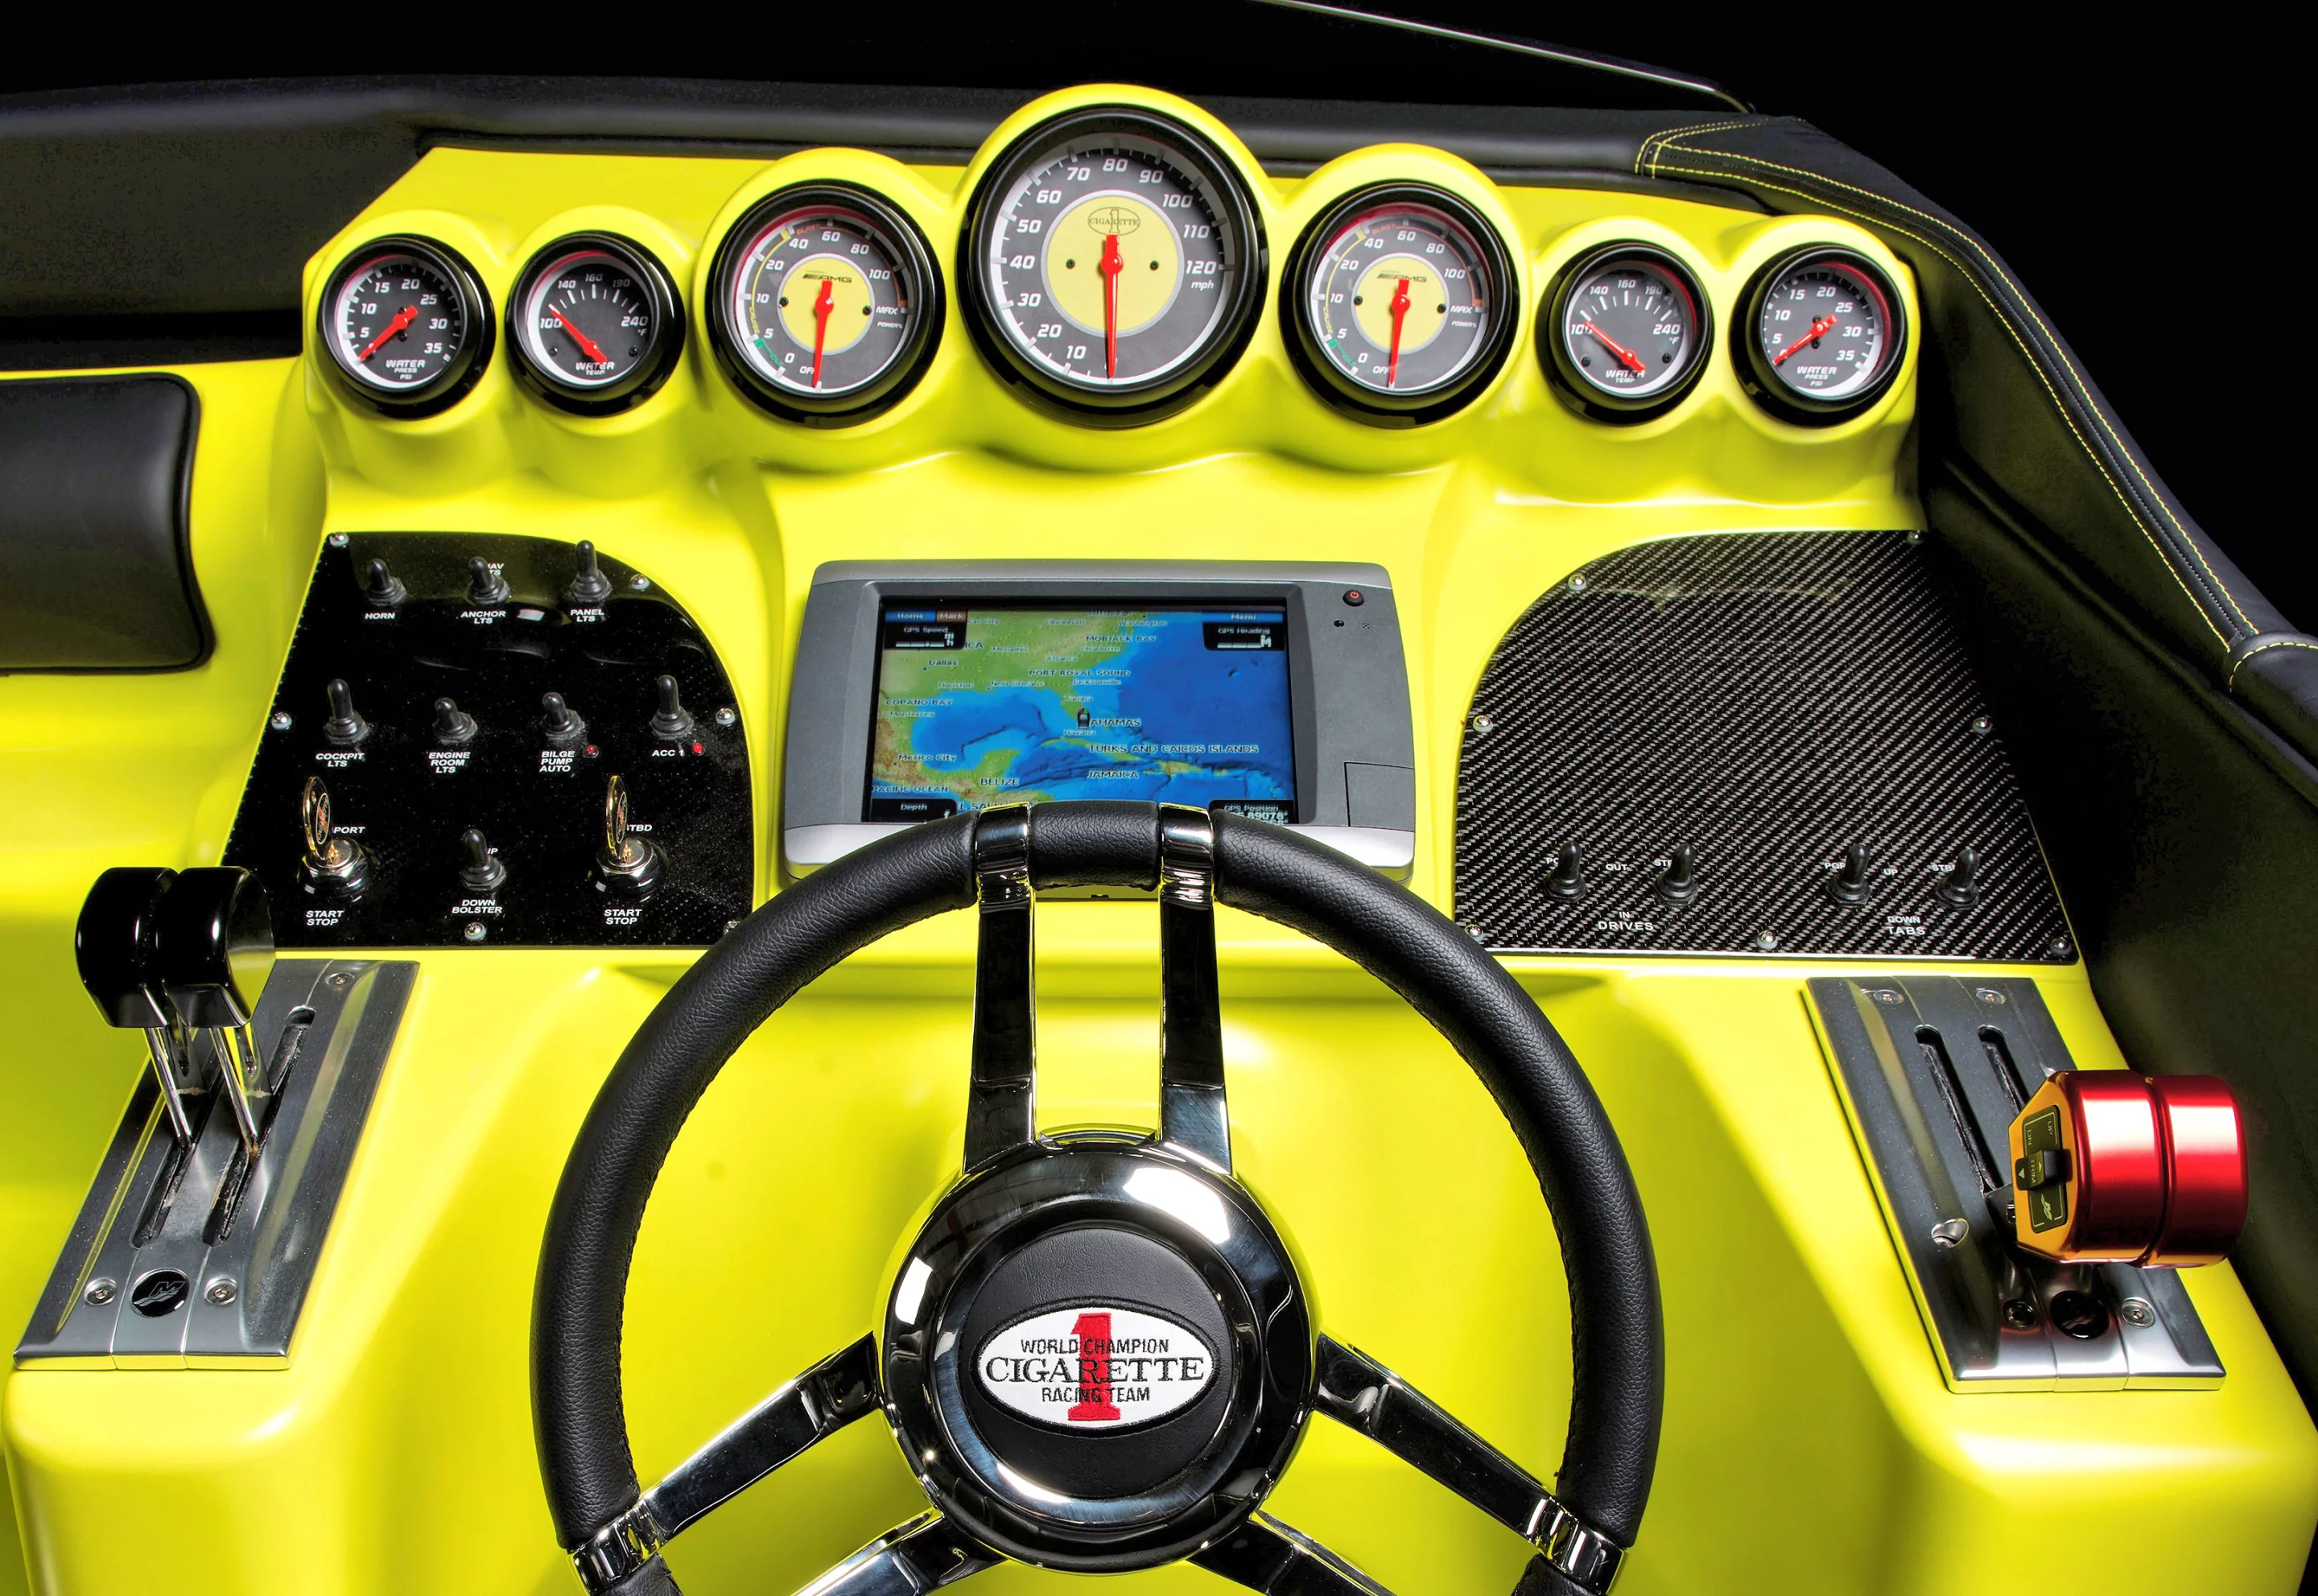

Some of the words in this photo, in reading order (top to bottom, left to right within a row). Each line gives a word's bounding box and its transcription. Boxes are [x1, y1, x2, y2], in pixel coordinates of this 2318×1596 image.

[1103, 159, 1127, 171] 80
[1067, 167, 1091, 181] 70
[1139, 170, 1163, 184] 90
[1036, 191, 1062, 204] 60
[1162, 194, 1193, 208] 100
[1017, 221, 1041, 233] 50
[1088, 217, 1140, 226] CIGARETTE
[822, 231, 840, 242] 60
[1183, 225, 1210, 238] 110
[1397, 230, 1417, 241] 60
[789, 238, 809, 250] 40
[1363, 238, 1384, 249] 40
[1425, 243, 1445, 254] 80
[850, 244, 869, 255] 80
[765, 260, 784, 270] 20
[1010, 255, 1035, 269] 40
[1186, 261, 1216, 274] 120
[1340, 260, 1359, 270] 20
[585, 273, 603, 283] 160
[869, 269, 890, 280] 100
[1444, 268, 1466, 279] 100
[375, 282, 390, 293] 15
[402, 279, 420, 290] 20
[558, 280, 575, 290] 140
[612, 278, 630, 289] 190
[1191, 280, 1214, 291] mph
[1618, 279, 1635, 289] 160
[1590, 286, 1608, 295] 140
[1644, 286, 1662, 295] 190
[1790, 289, 1804, 300] 15
[1817, 287, 1836, 297] 20
[421, 295, 437, 305] 25
[757, 294, 769, 303] 10
[1017, 294, 1041, 307] 30
[1330, 294, 1343, 303] 10
[361, 303, 377, 315] 10
[876, 306, 899, 315] MAX
[1450, 305, 1473, 314] MAX
[1835, 302, 1853, 313] 25
[1775, 310, 1791, 321] 10
[429, 319, 448, 329] 30
[540, 318, 563, 328] 100
[621, 316, 648, 328] 240
[877, 321, 903, 329] POWER%
[360, 327, 369, 338] 5
[764, 328, 774, 339] 5
[1037, 324, 1062, 337] 20
[1337, 328, 1347, 339] 5
[1652, 324, 1680, 335] 240
[1842, 326, 1862, 337] 30
[1771, 333, 1783, 344] 5
[424, 343, 442, 353] 35
[1066, 346, 1086, 359] 10
[785, 353, 795, 364] 0
[1358, 353, 1368, 364] 0
[1836, 350, 1855, 361] 35
[386, 360, 425, 368] WATER
[575, 361, 615, 370] WATER
[1796, 366, 1837, 375] WATER
[1231, 612, 1256, 621] Menu
[922, 626, 949, 634] Speed
[1237, 627, 1271, 636] Heading
[1091, 719, 1140, 727] AHAMAS
[1161, 745, 1206, 753] CAICOS
[1209, 745, 1259, 753] ISLANDS
[541, 757, 573, 765] PUMP
[936, 754, 957, 762] City
[435, 765, 456, 773] LTS
[539, 765, 571, 773] AUTO
[980, 778, 1019, 786] BELIZE
[913, 785, 949, 793] OCEAN
[901, 803, 927, 811] Depth
[1244, 804, 1279, 812] Position
[306, 910, 344, 918] START
[604, 909, 642, 917] START
[307, 918, 339, 926] STOP
[605, 917, 637, 925] STOP
[1887, 916, 1921, 924] DOWN
[1598, 922, 1654, 931] DRIVES
[1887, 927, 1926, 935] TABS
[2048, 1120, 2052, 1136] UP
[2027, 1129, 2032, 1145] DN
[1021, 1338, 1079, 1354] WORLD
[1084, 1338, 1169, 1354] CHAMPION
[985, 1356, 1204, 1383] CIGARETTE
[1041, 1387, 1101, 1403] RACING
[1109, 1387, 1150, 1402] TEAM
